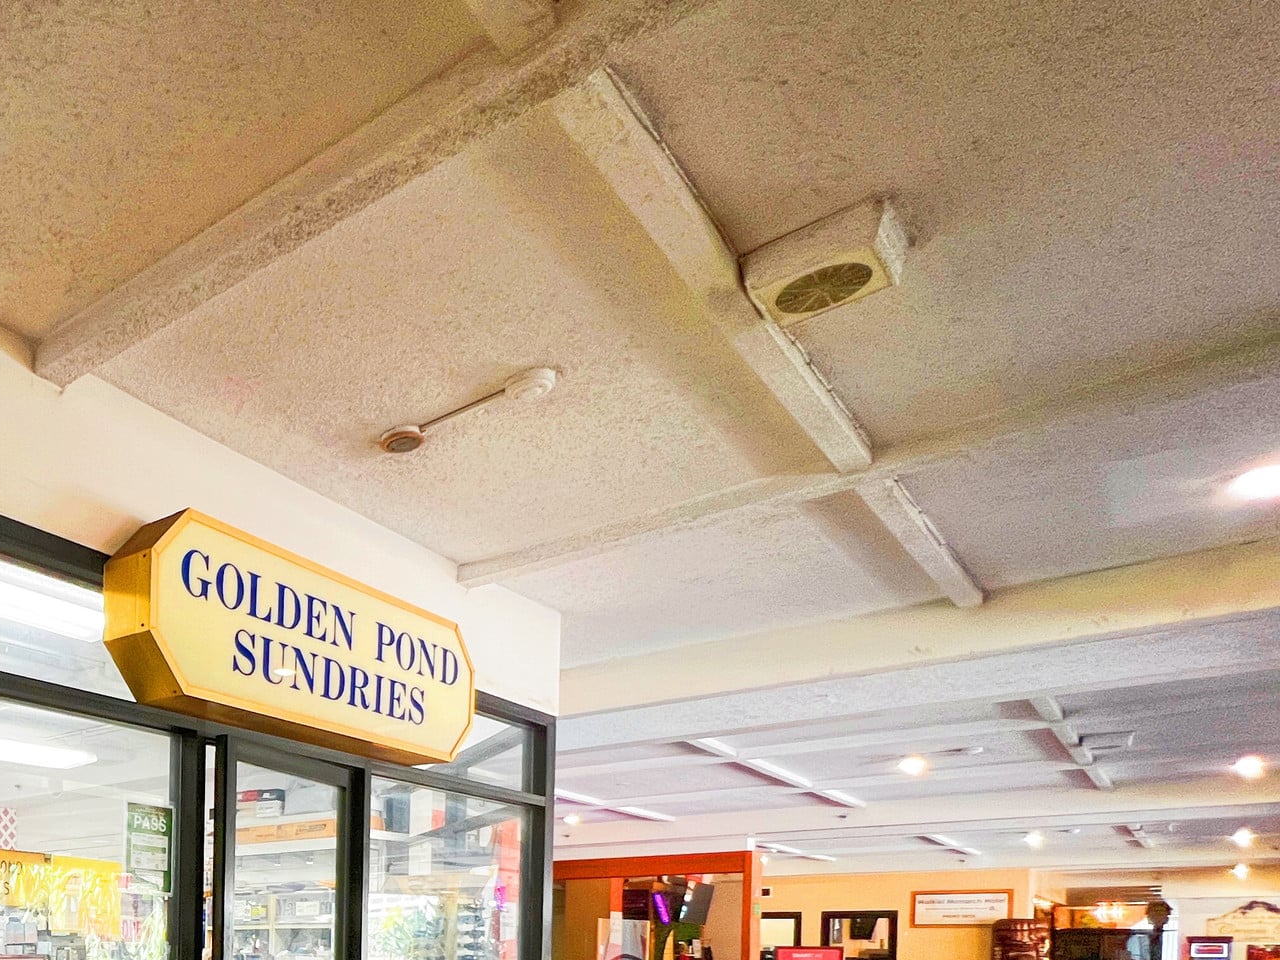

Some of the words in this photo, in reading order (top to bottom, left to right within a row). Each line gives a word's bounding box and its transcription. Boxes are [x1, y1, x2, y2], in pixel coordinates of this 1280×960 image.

[180, 548, 357, 652] GOLDEN
[375, 620, 460, 687] POND
[232, 628, 426, 727] SUNDRIES
[133, 814, 167, 833] PASS
